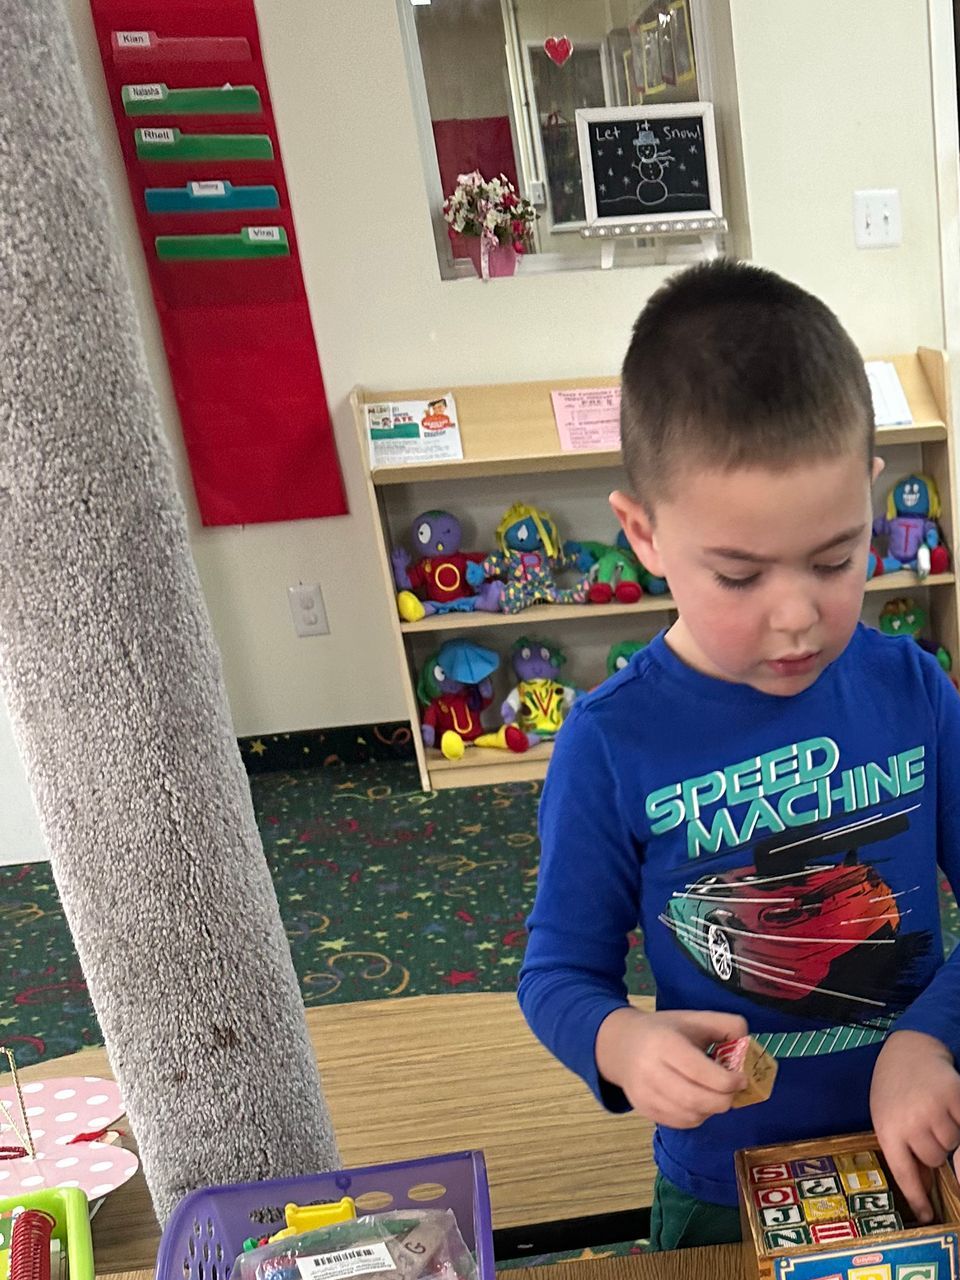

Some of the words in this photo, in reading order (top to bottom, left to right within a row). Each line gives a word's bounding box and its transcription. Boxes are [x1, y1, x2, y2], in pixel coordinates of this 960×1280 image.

[596, 126, 621, 141] Let
[663, 124, 701, 141] Snow!
[645, 736, 840, 836] SPEED
[687, 745, 925, 859] MACHINE
